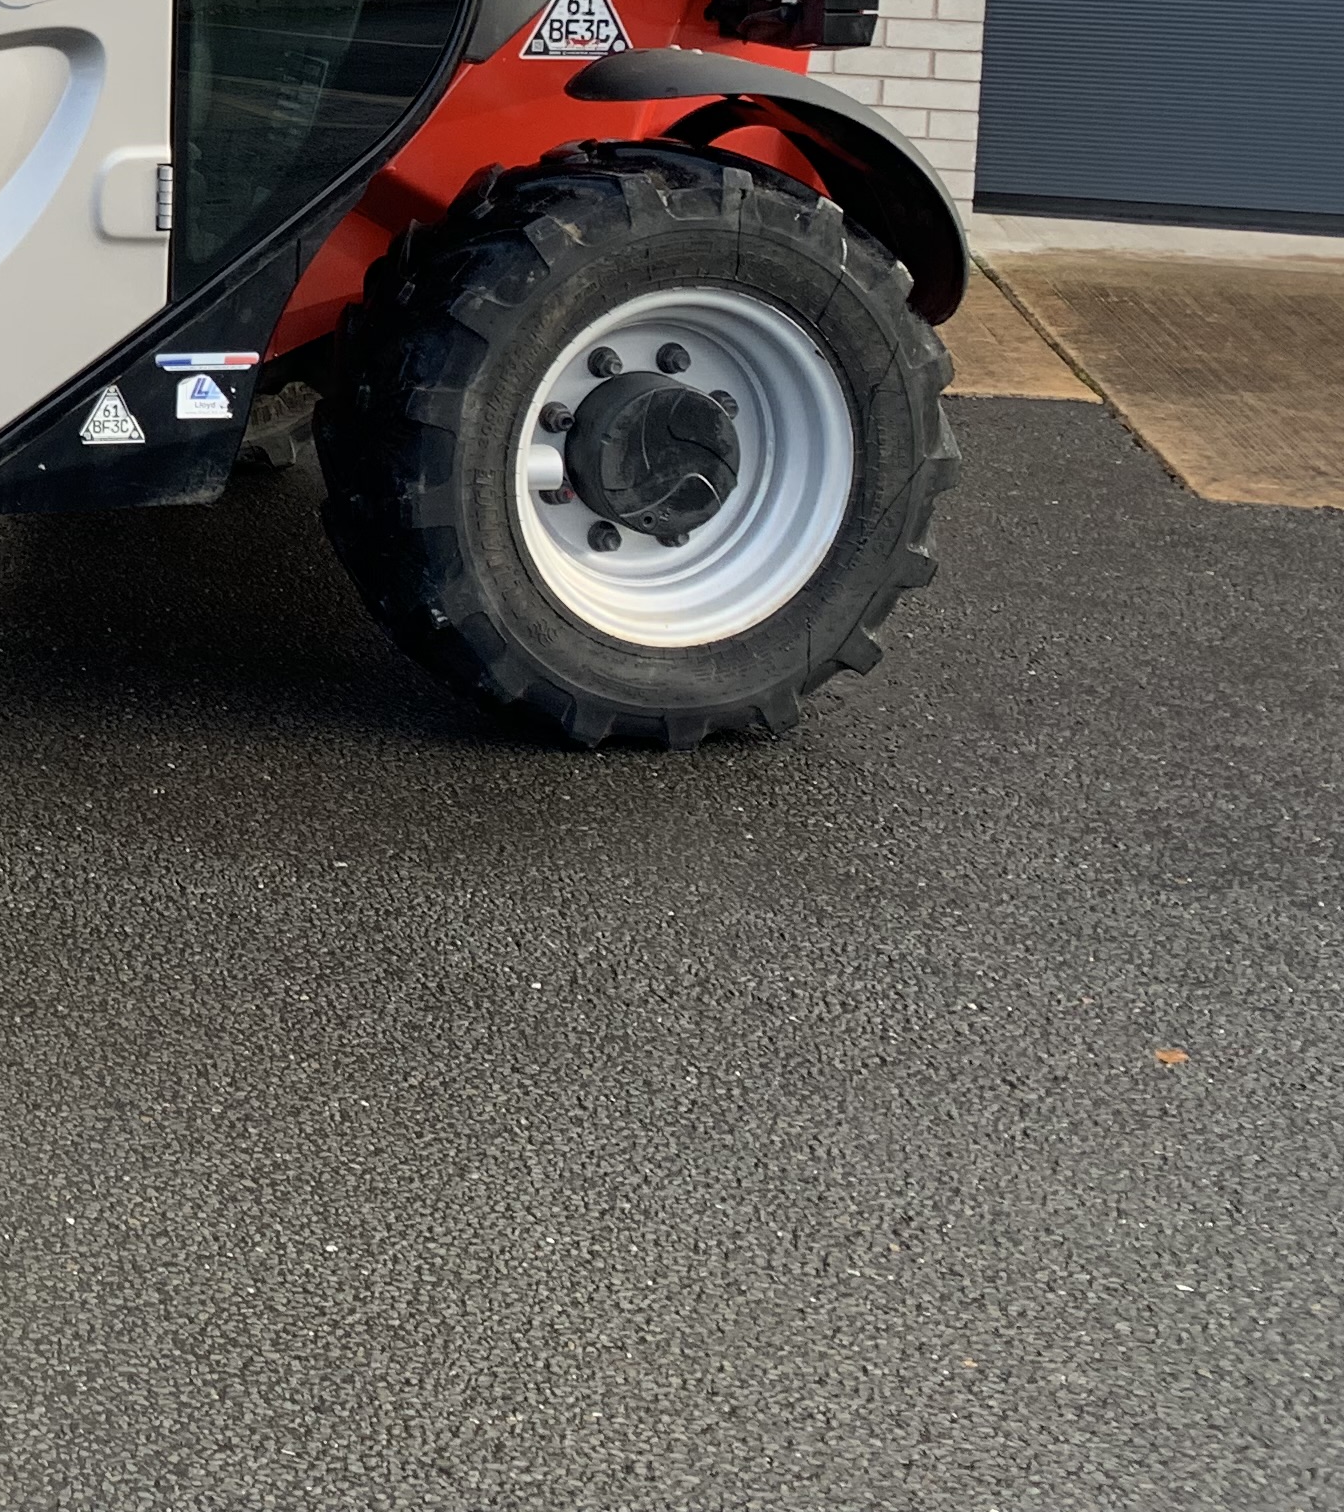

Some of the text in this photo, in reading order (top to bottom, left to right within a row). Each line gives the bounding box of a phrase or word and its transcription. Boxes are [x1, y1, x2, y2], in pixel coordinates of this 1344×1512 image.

[548, 19, 611, 44] BF3C
[103, 404, 120, 418] 61
[194, 401, 216, 410] Lloyd
[93, 419, 129, 434] BF3C
